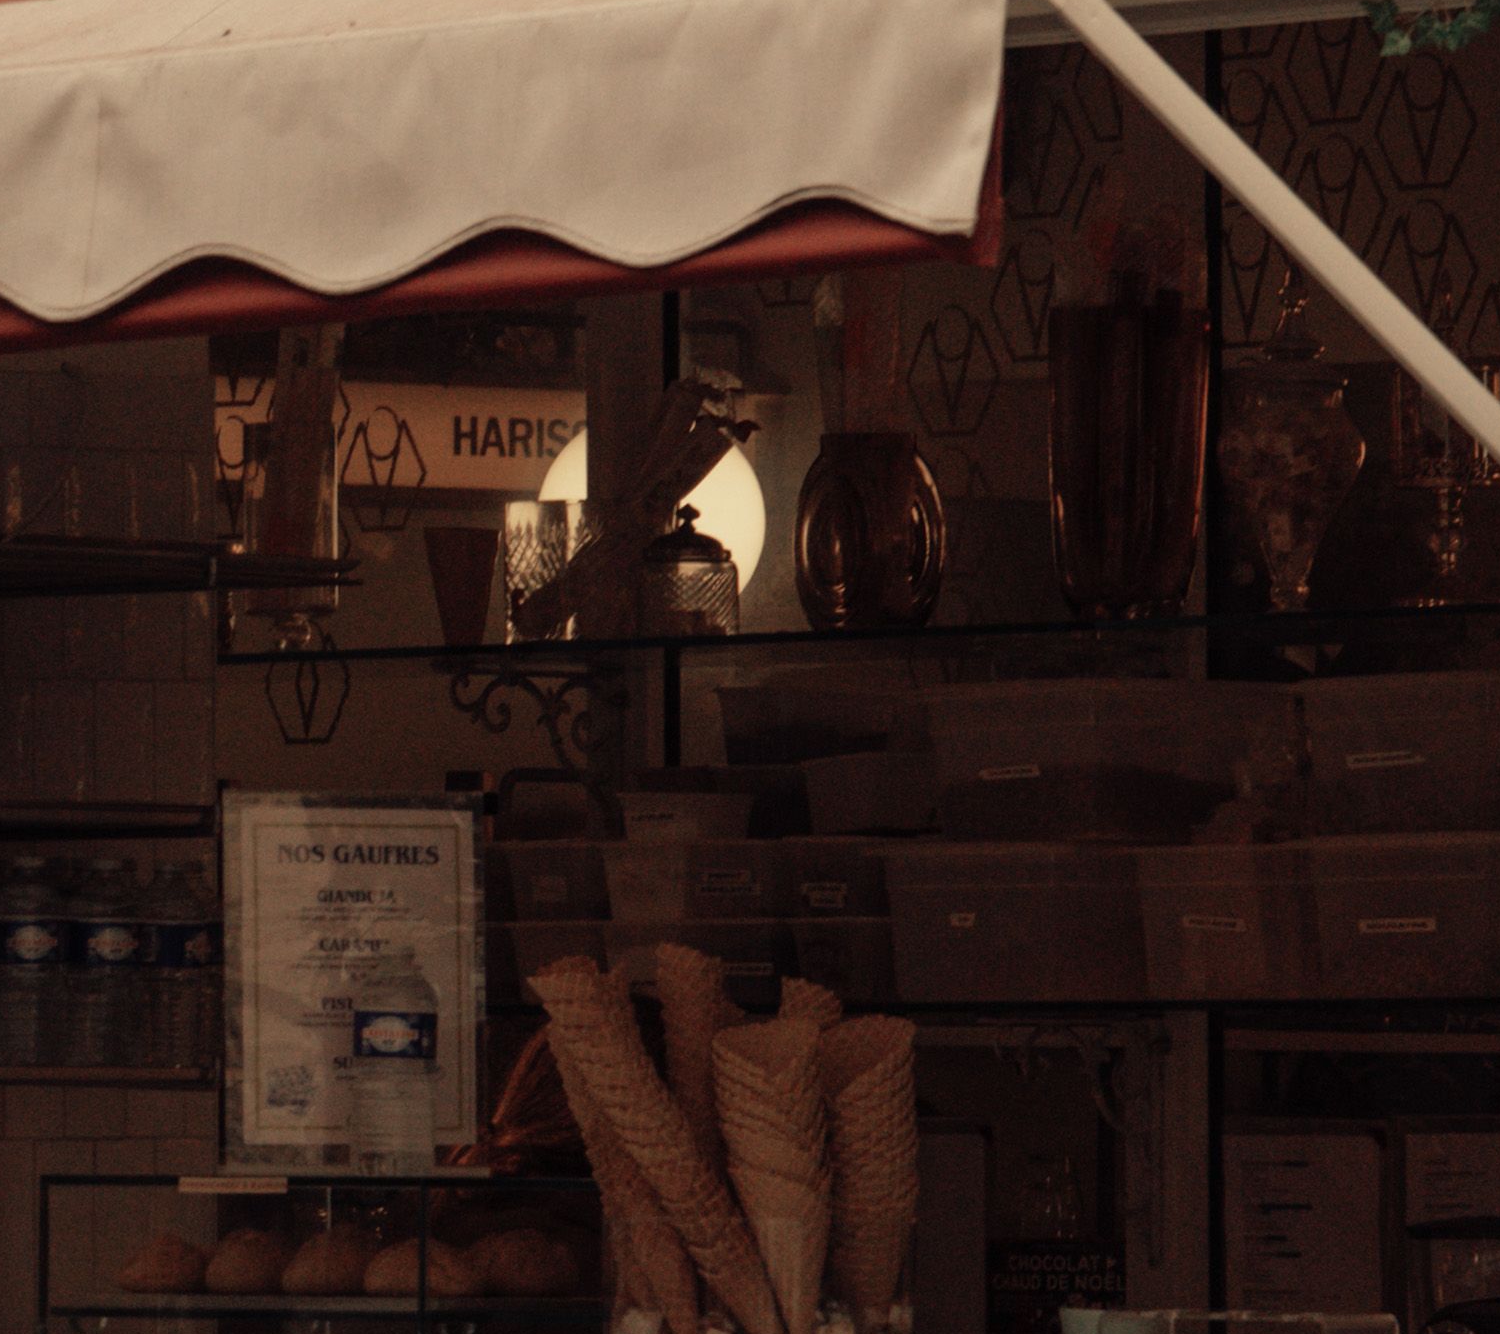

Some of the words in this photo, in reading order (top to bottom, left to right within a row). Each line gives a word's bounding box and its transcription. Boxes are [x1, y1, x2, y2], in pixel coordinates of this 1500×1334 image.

[453, 416, 587, 458] HARIS
[277, 843, 325, 865] NOS
[332, 844, 440, 866] GAUFRES
